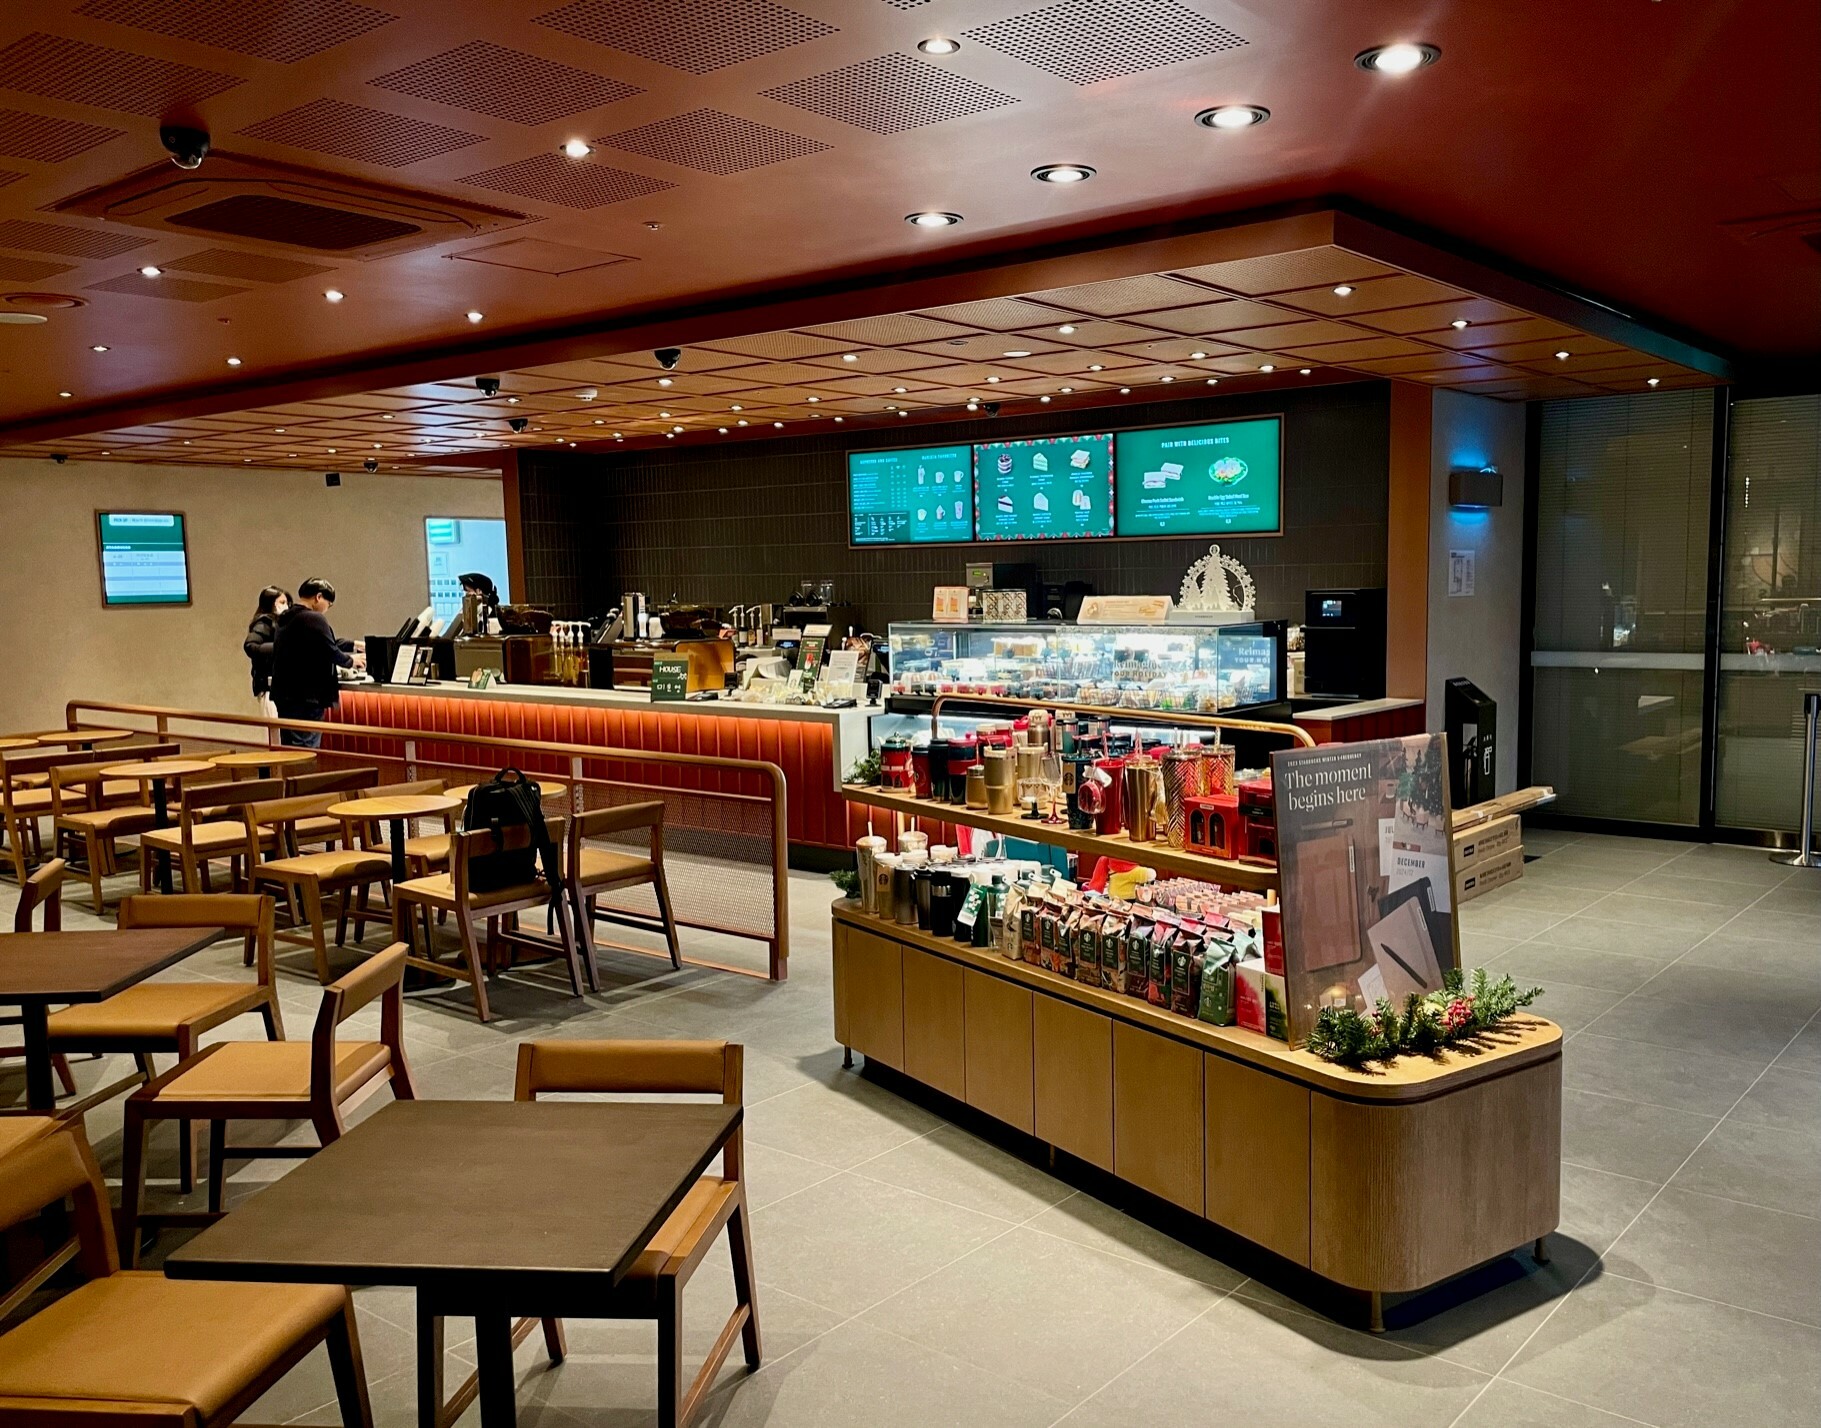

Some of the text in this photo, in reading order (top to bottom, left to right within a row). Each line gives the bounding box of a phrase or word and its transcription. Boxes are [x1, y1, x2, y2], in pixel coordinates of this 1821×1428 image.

[1174, 440, 1187, 448] WITH
[1188, 438, 1214, 447] DELICIOUS
[1215, 436, 1230, 445] BITES
[659, 665, 682, 673] HOUSE
[1132, 670, 1167, 678] HOLIDAY
[1322, 755, 1336, 763] WINTER
[1284, 762, 1372, 790] The moment
[1288, 789, 1334, 812] begins
[1336, 785, 1366, 804] here
[1397, 857, 1426, 868] DECEMBER
